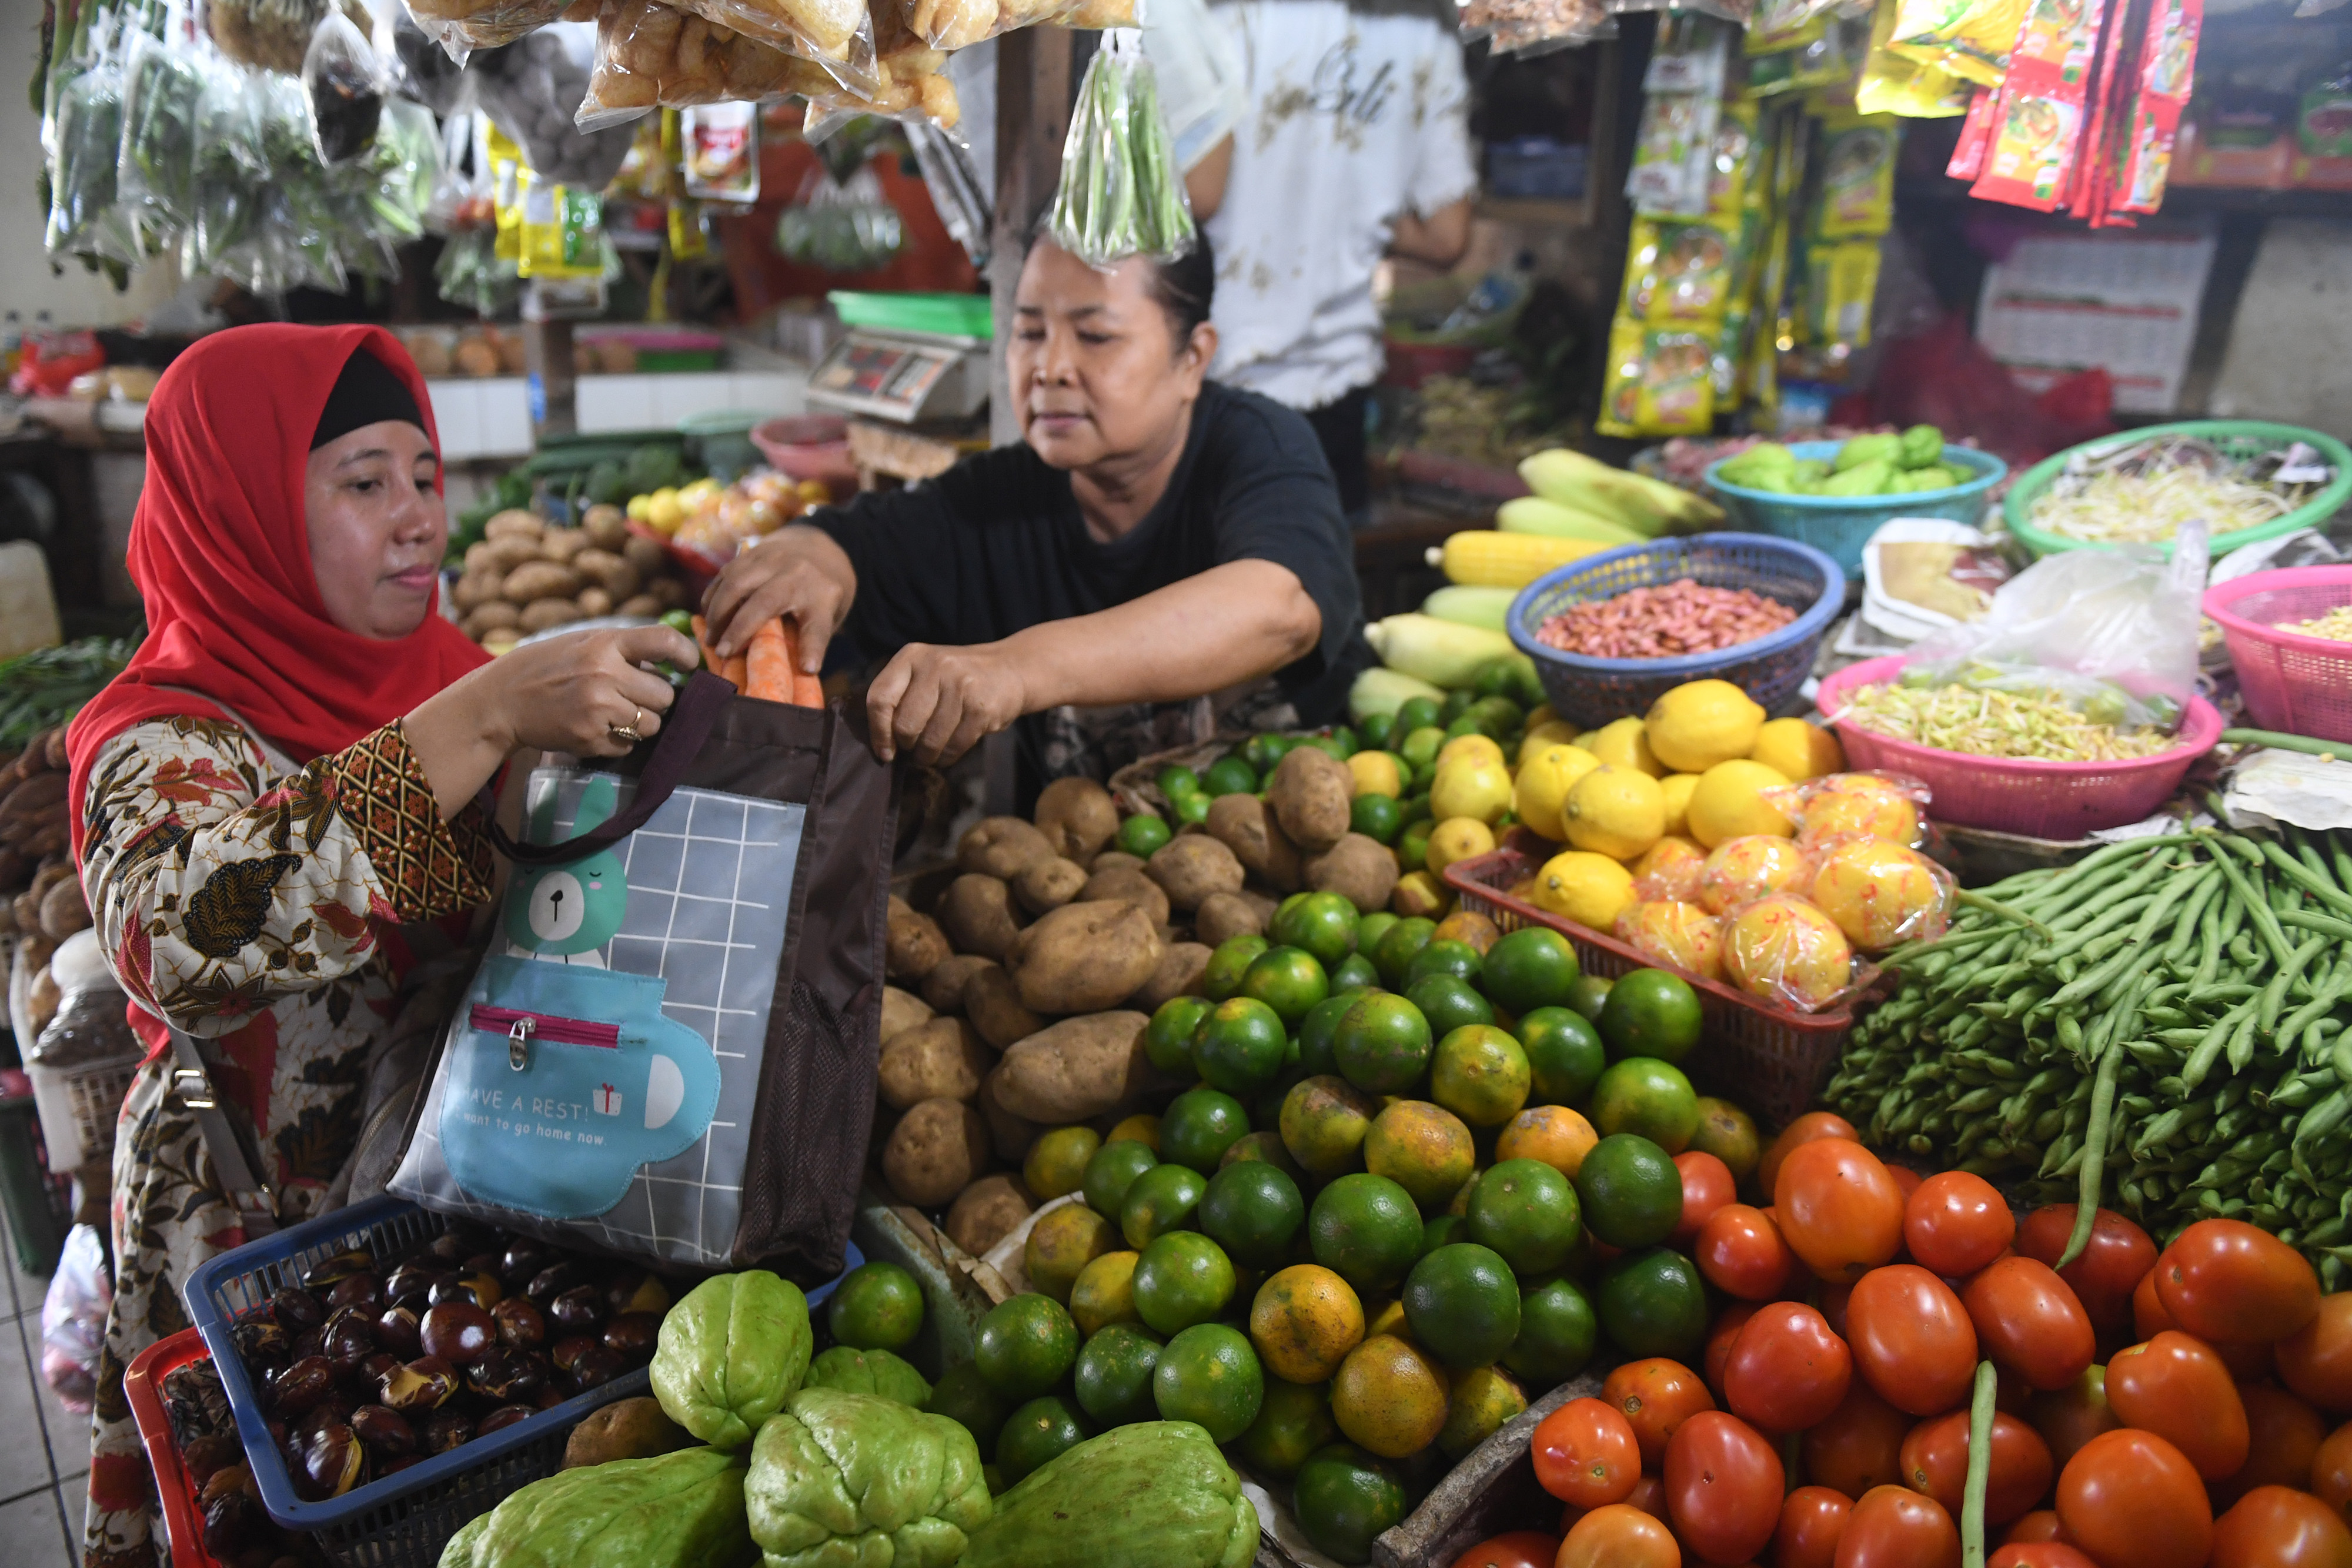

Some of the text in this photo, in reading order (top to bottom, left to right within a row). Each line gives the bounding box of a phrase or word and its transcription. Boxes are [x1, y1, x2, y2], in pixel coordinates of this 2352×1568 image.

[511, 1095, 522, 1112] A
[532, 1096, 588, 1122] REST!
[463, 1112, 490, 1126] want
[496, 1117, 509, 1130] to
[514, 1122, 530, 1136] go
[536, 1122, 572, 1141] home
